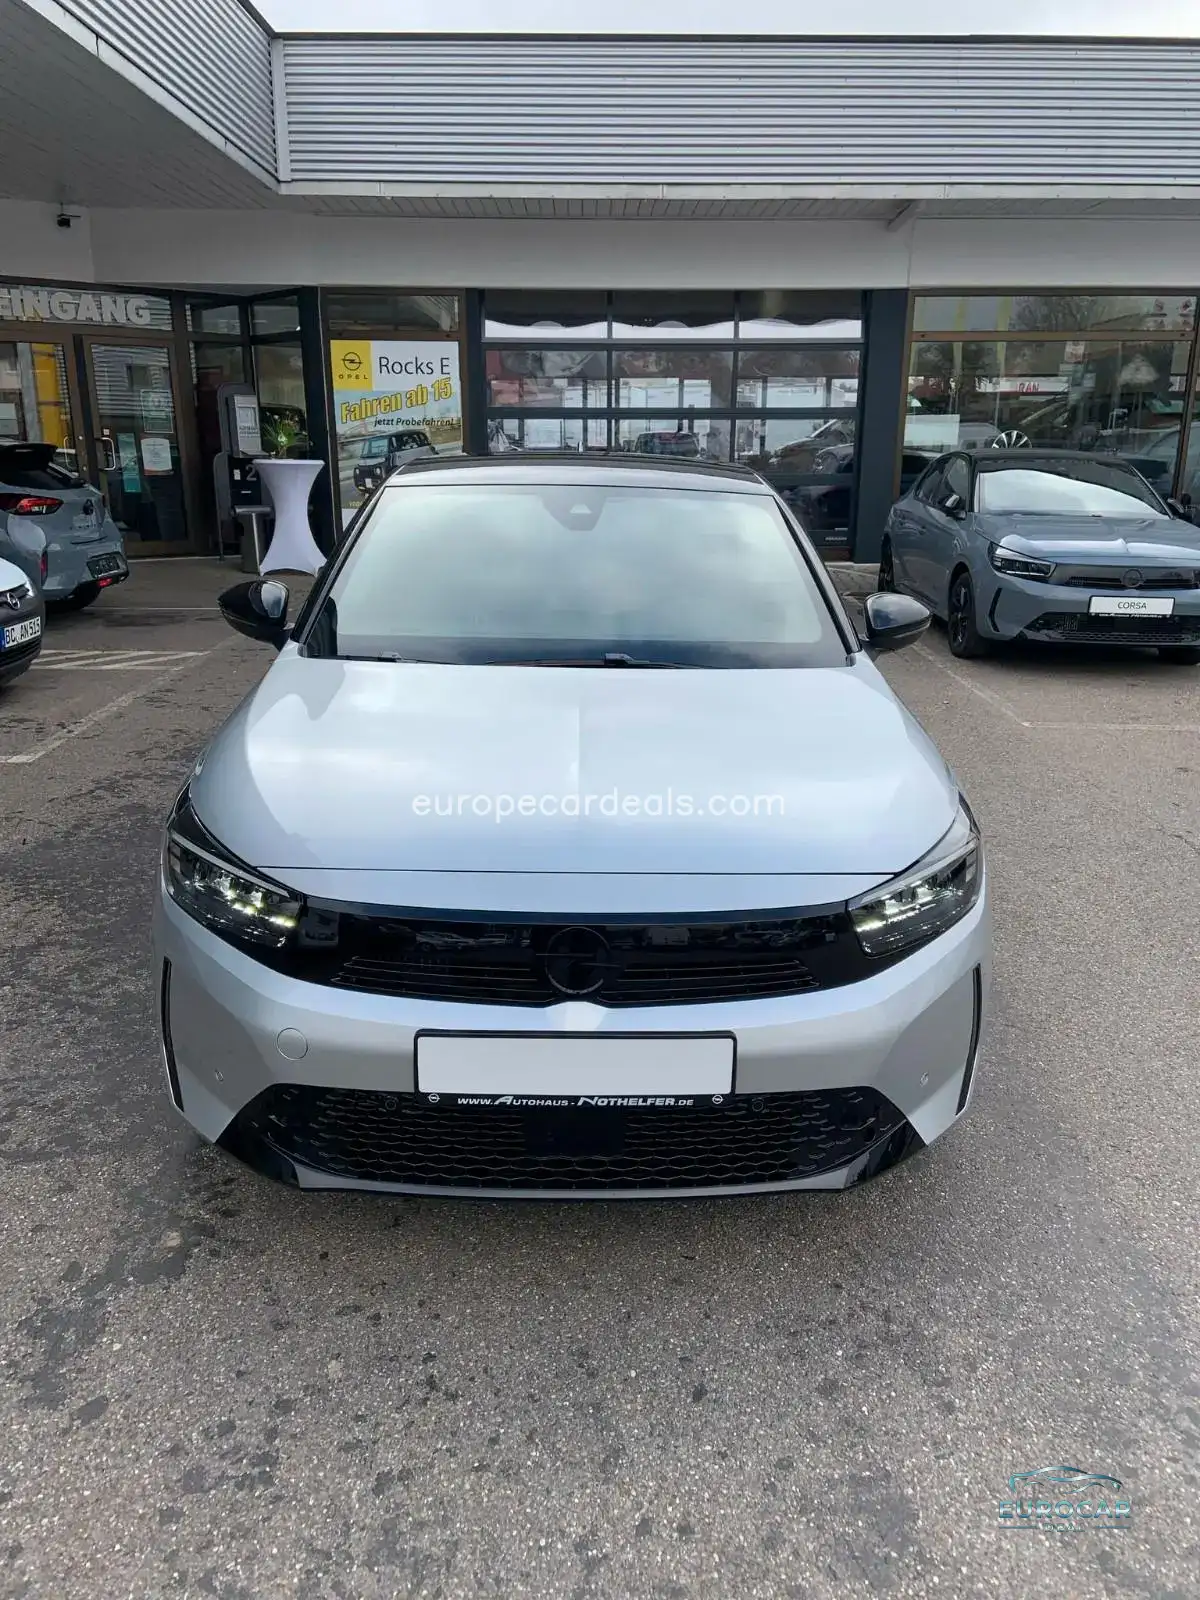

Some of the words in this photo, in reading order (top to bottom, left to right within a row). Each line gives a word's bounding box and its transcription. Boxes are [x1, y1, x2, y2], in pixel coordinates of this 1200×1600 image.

[0, 288, 151, 325] EINGANG
[378, 356, 434, 375] Rocks
[440, 357, 451, 375] E
[340, 392, 402, 424] Fahren
[405, 383, 428, 408] ab
[431, 377, 453, 401] 15
[374, 417, 394, 428] jetzt
[396, 417, 454, 427] Probefahren!
[245, 463, 257, 481] 2
[1117, 601, 1148, 610] CORSA
[5, 628, 16, 645] BC
